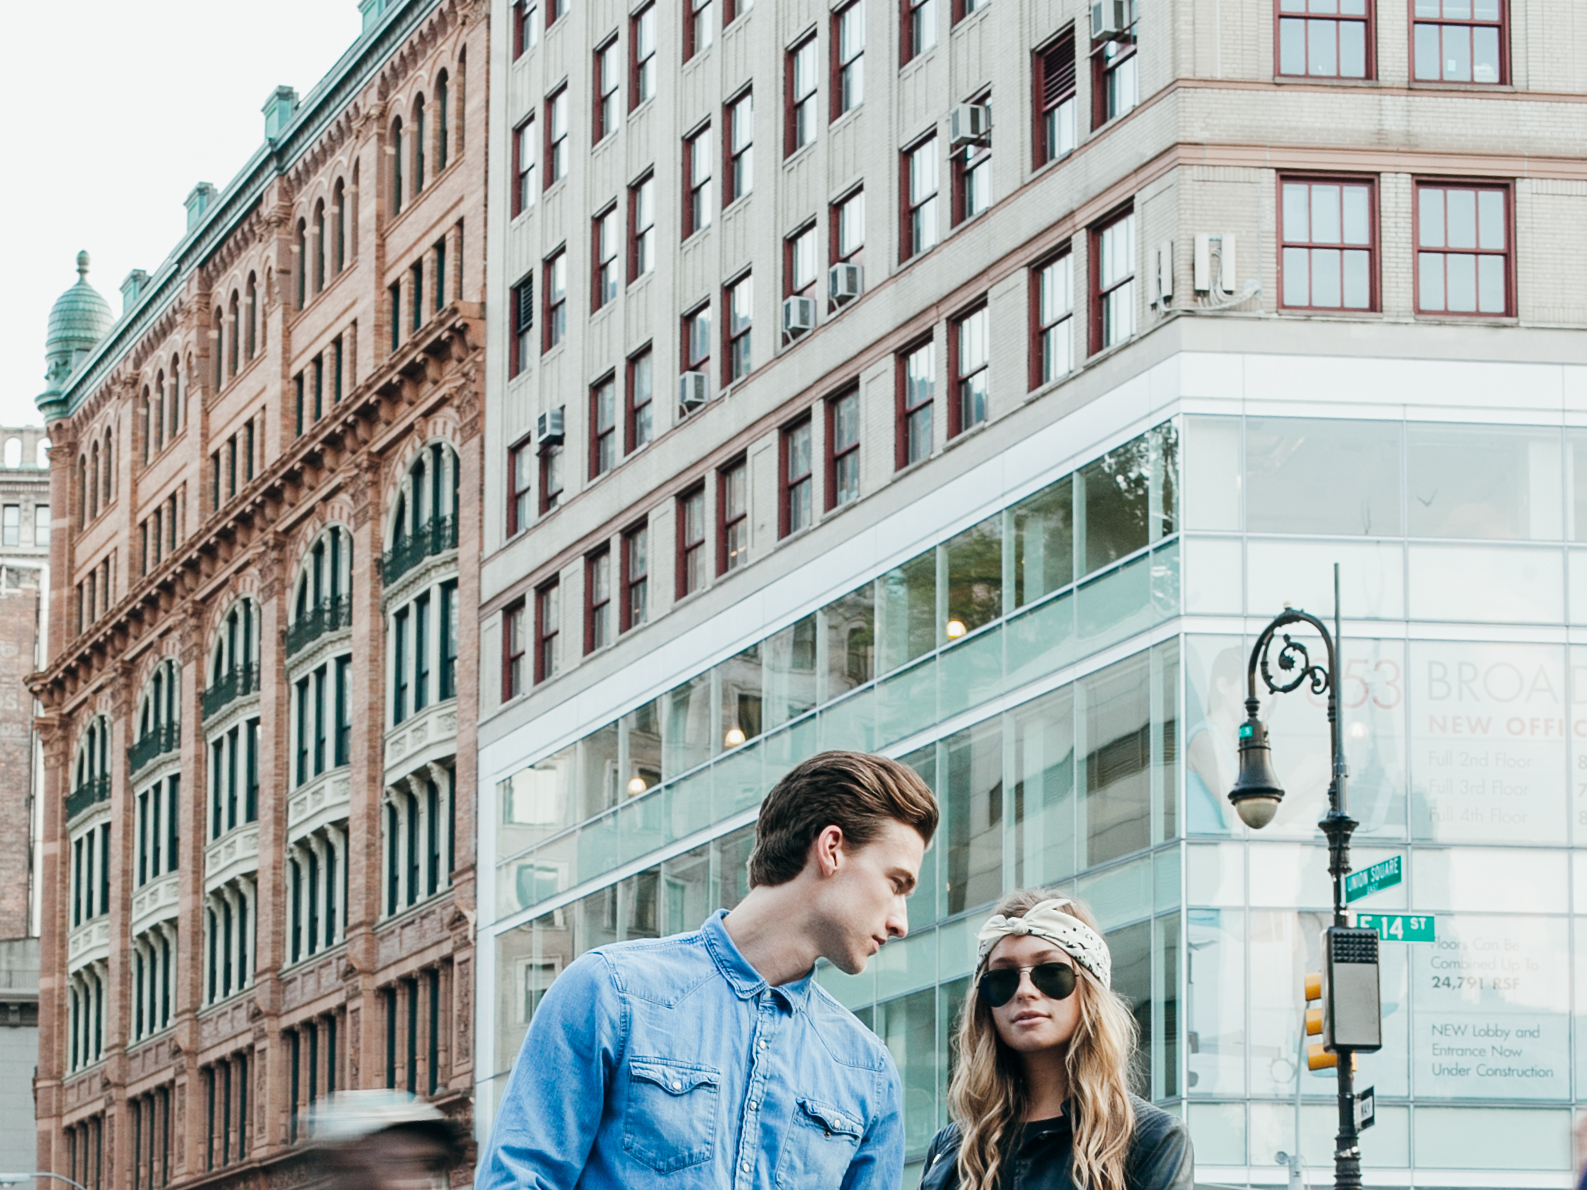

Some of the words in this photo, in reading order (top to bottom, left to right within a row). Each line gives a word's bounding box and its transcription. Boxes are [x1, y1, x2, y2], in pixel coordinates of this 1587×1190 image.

[1428, 714, 1493, 735] NEW
[1428, 750, 1453, 768] Full
[1459, 750, 1488, 768] 2nd
[1495, 751, 1533, 769] Floor
[1428, 777, 1453, 795] Full
[1460, 778, 1485, 795] 3rd
[1492, 779, 1530, 796] Floor
[1428, 805, 1453, 823] Full
[1460, 806, 1484, 823] 4th
[1490, 807, 1528, 825] Floor
[1347, 870, 1369, 892] UNION
[1371, 857, 1399, 882] SQUARE
[1381, 916, 1404, 940] 14
[1410, 917, 1427, 930] ST
[1472, 937, 1499, 951] Can
[1504, 938, 1520, 951] Be
[1430, 955, 1496, 970] Combined
[1501, 958, 1520, 974] Up
[1524, 958, 1540, 971] To
[1431, 975, 1484, 991] 24,791
[1492, 977, 1520, 990] RSF
[1431, 1024, 1468, 1037] NEW
[1473, 1023, 1511, 1041] Lobby
[1515, 1024, 1540, 1038] and
[1432, 1043, 1486, 1057] Entrance
[1491, 1045, 1522, 1058] Now
[1432, 1062, 1471, 1077] Under
[1476, 1063, 1554, 1078] Construction
